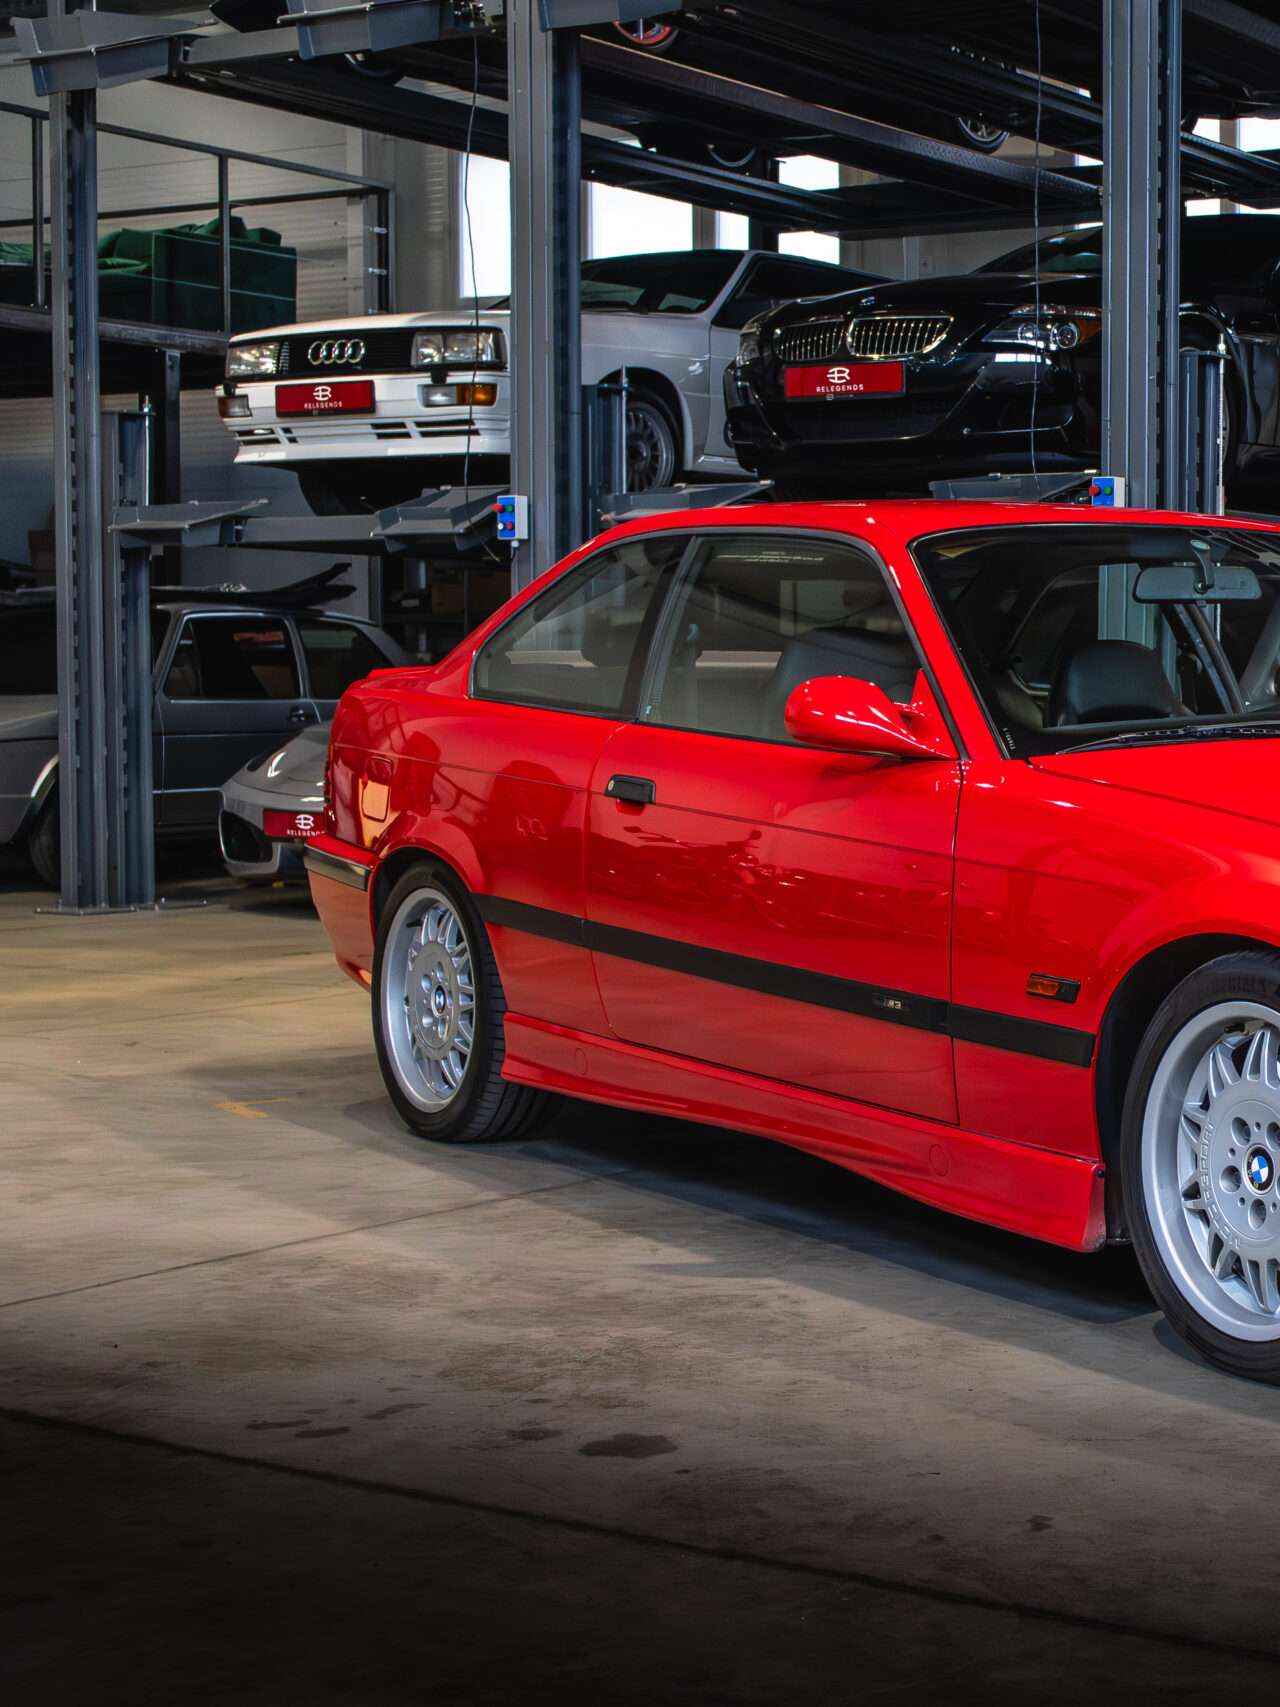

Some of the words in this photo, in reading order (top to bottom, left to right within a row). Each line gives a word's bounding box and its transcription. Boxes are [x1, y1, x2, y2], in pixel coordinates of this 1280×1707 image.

[816, 383, 864, 393] RELEGENDS
[304, 400, 343, 409] RELEGENDS
[884, 998, 902, 1009] M3
[1199, 1121, 1242, 1250] MOTORSPORT
